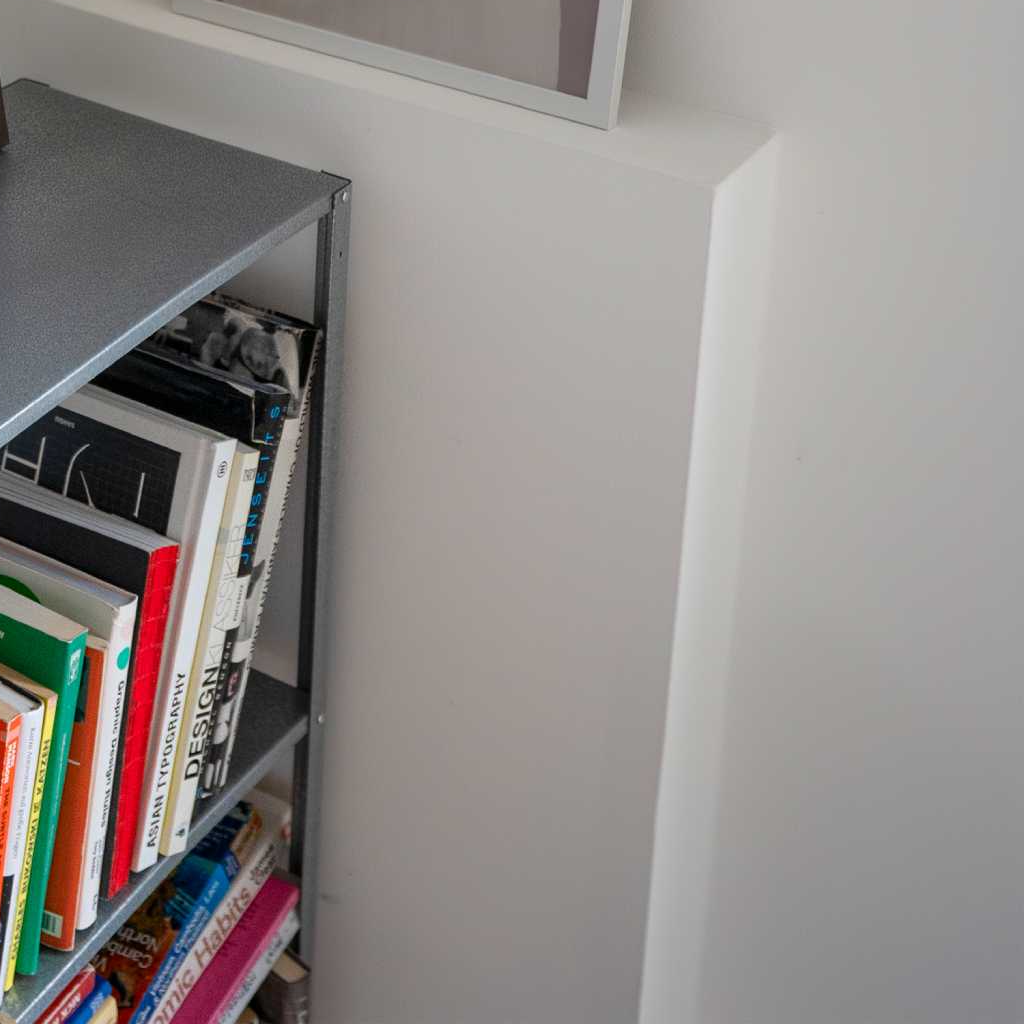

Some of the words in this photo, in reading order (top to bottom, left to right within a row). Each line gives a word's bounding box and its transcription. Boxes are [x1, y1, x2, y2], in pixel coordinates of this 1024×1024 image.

[240, 405, 281, 565] JENSEITS
[111, 679, 126, 731] Graphic
[36, 739, 51, 794] KATZEN
[105, 738, 117, 786] Design
[147, 794, 165, 848] ASIAN
[157, 672, 186, 793] TYPOGRAPHY
[100, 789, 110, 828] Rules
[194, 887, 252, 969] Habits
